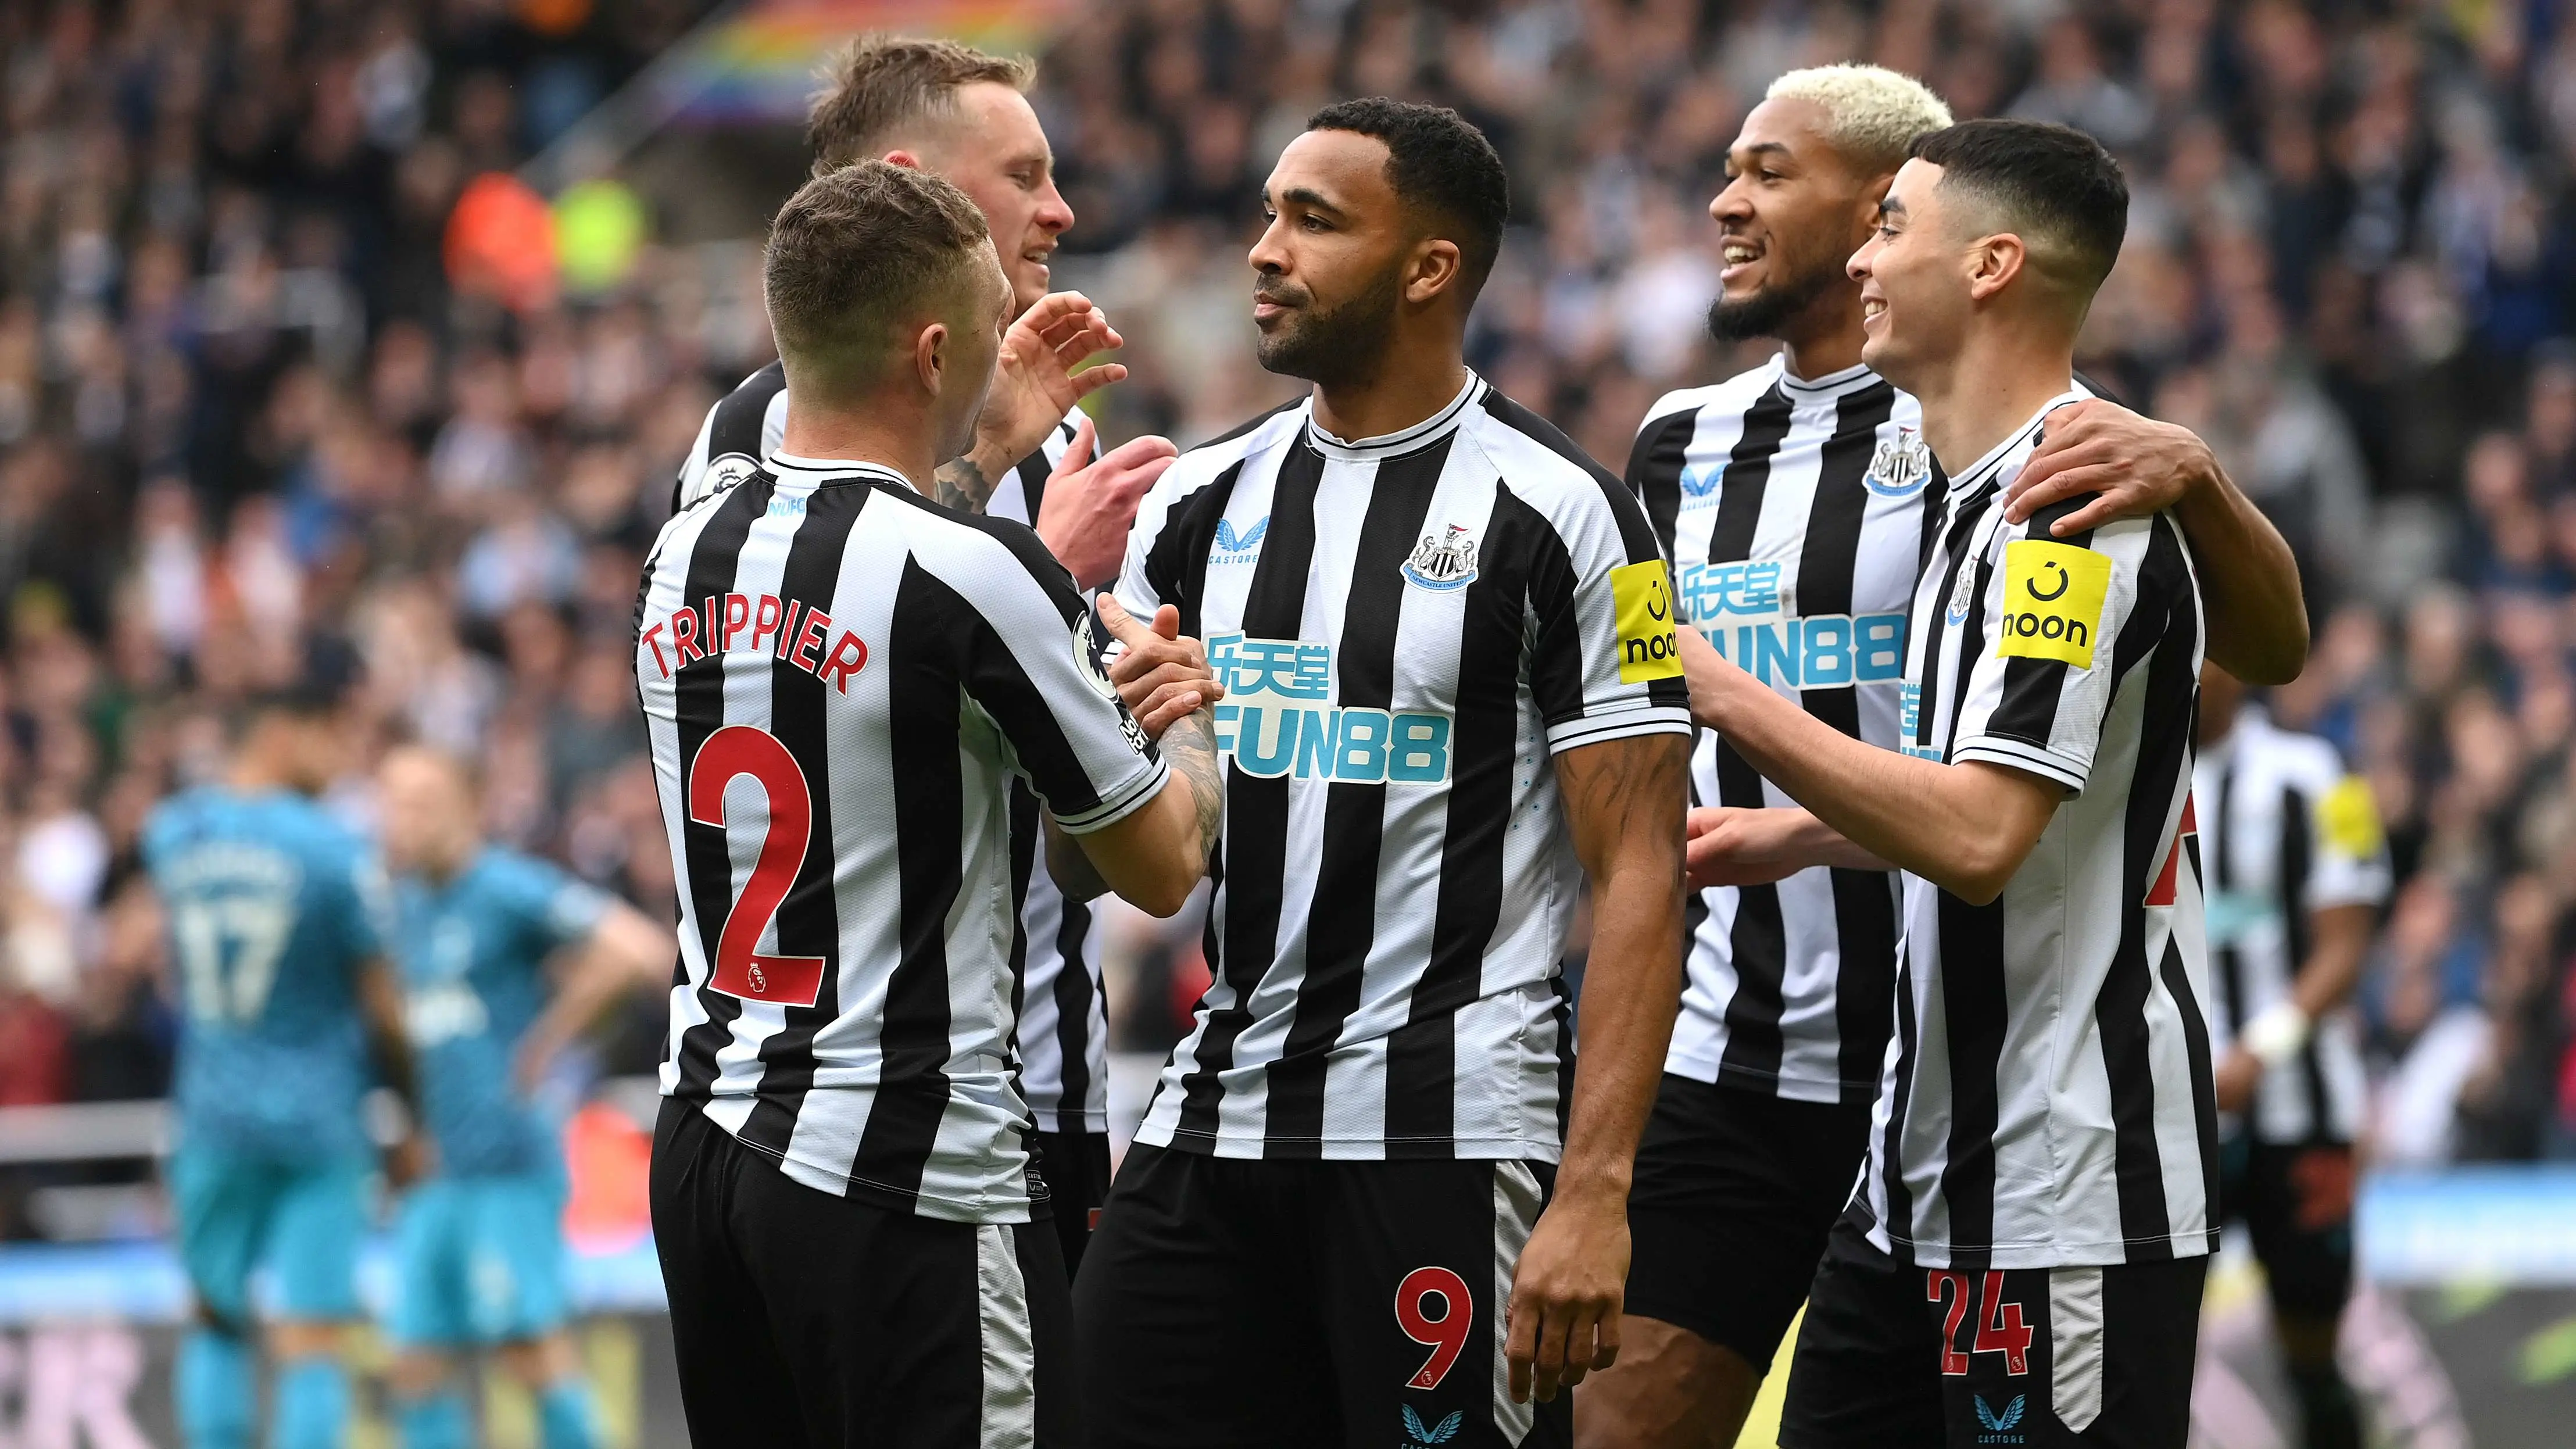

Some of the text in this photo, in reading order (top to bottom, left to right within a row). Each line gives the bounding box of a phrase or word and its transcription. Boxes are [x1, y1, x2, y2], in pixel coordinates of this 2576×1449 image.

[767, 497, 806, 517] NUFC
[1208, 554, 1258, 564] CASTORE
[1411, 575, 1442, 588] NEWCASTLE
[1683, 561, 1781, 621] 乐天堂
[641, 592, 870, 698] TRIPPIER
[1626, 632, 1679, 664] noo
[1701, 614, 1908, 689] UN88
[2002, 612, 2088, 647] noon
[689, 724, 826, 1008] 2
[178, 898, 296, 1023] 17
[1395, 1266, 1473, 1390] 9
[1927, 1269, 2034, 1376] 24
[1977, 1434, 2025, 1444] CASTORE
